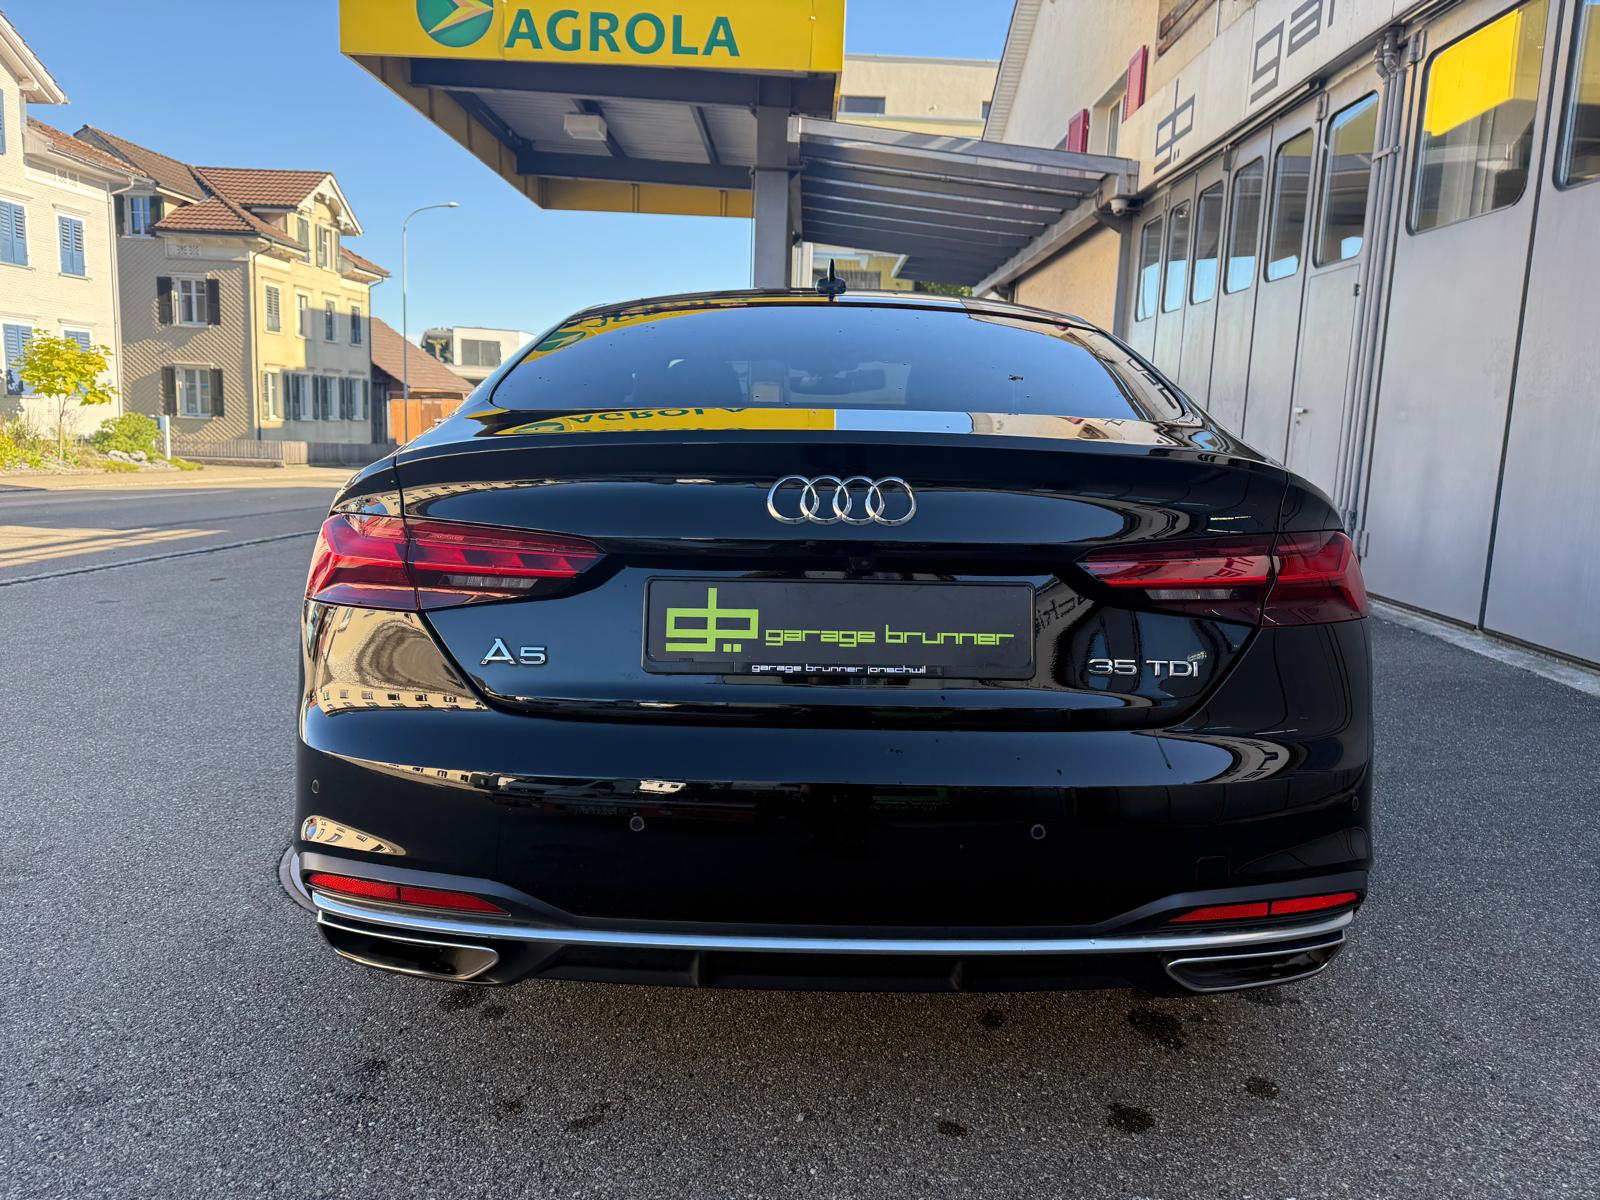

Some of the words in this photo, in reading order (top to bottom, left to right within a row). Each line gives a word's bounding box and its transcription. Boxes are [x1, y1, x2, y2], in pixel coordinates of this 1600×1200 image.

[505, 8, 740, 57] AGROLA
[765, 629, 876, 648] garage
[885, 624, 1015, 646] brunner
[480, 638, 546, 665] A5
[751, 664, 802, 674] garage
[805, 663, 864, 673] brunner
[867, 665, 927, 675] jonschwil
[1088, 658, 1138, 676] 35
[1146, 659, 1199, 678] TDI
